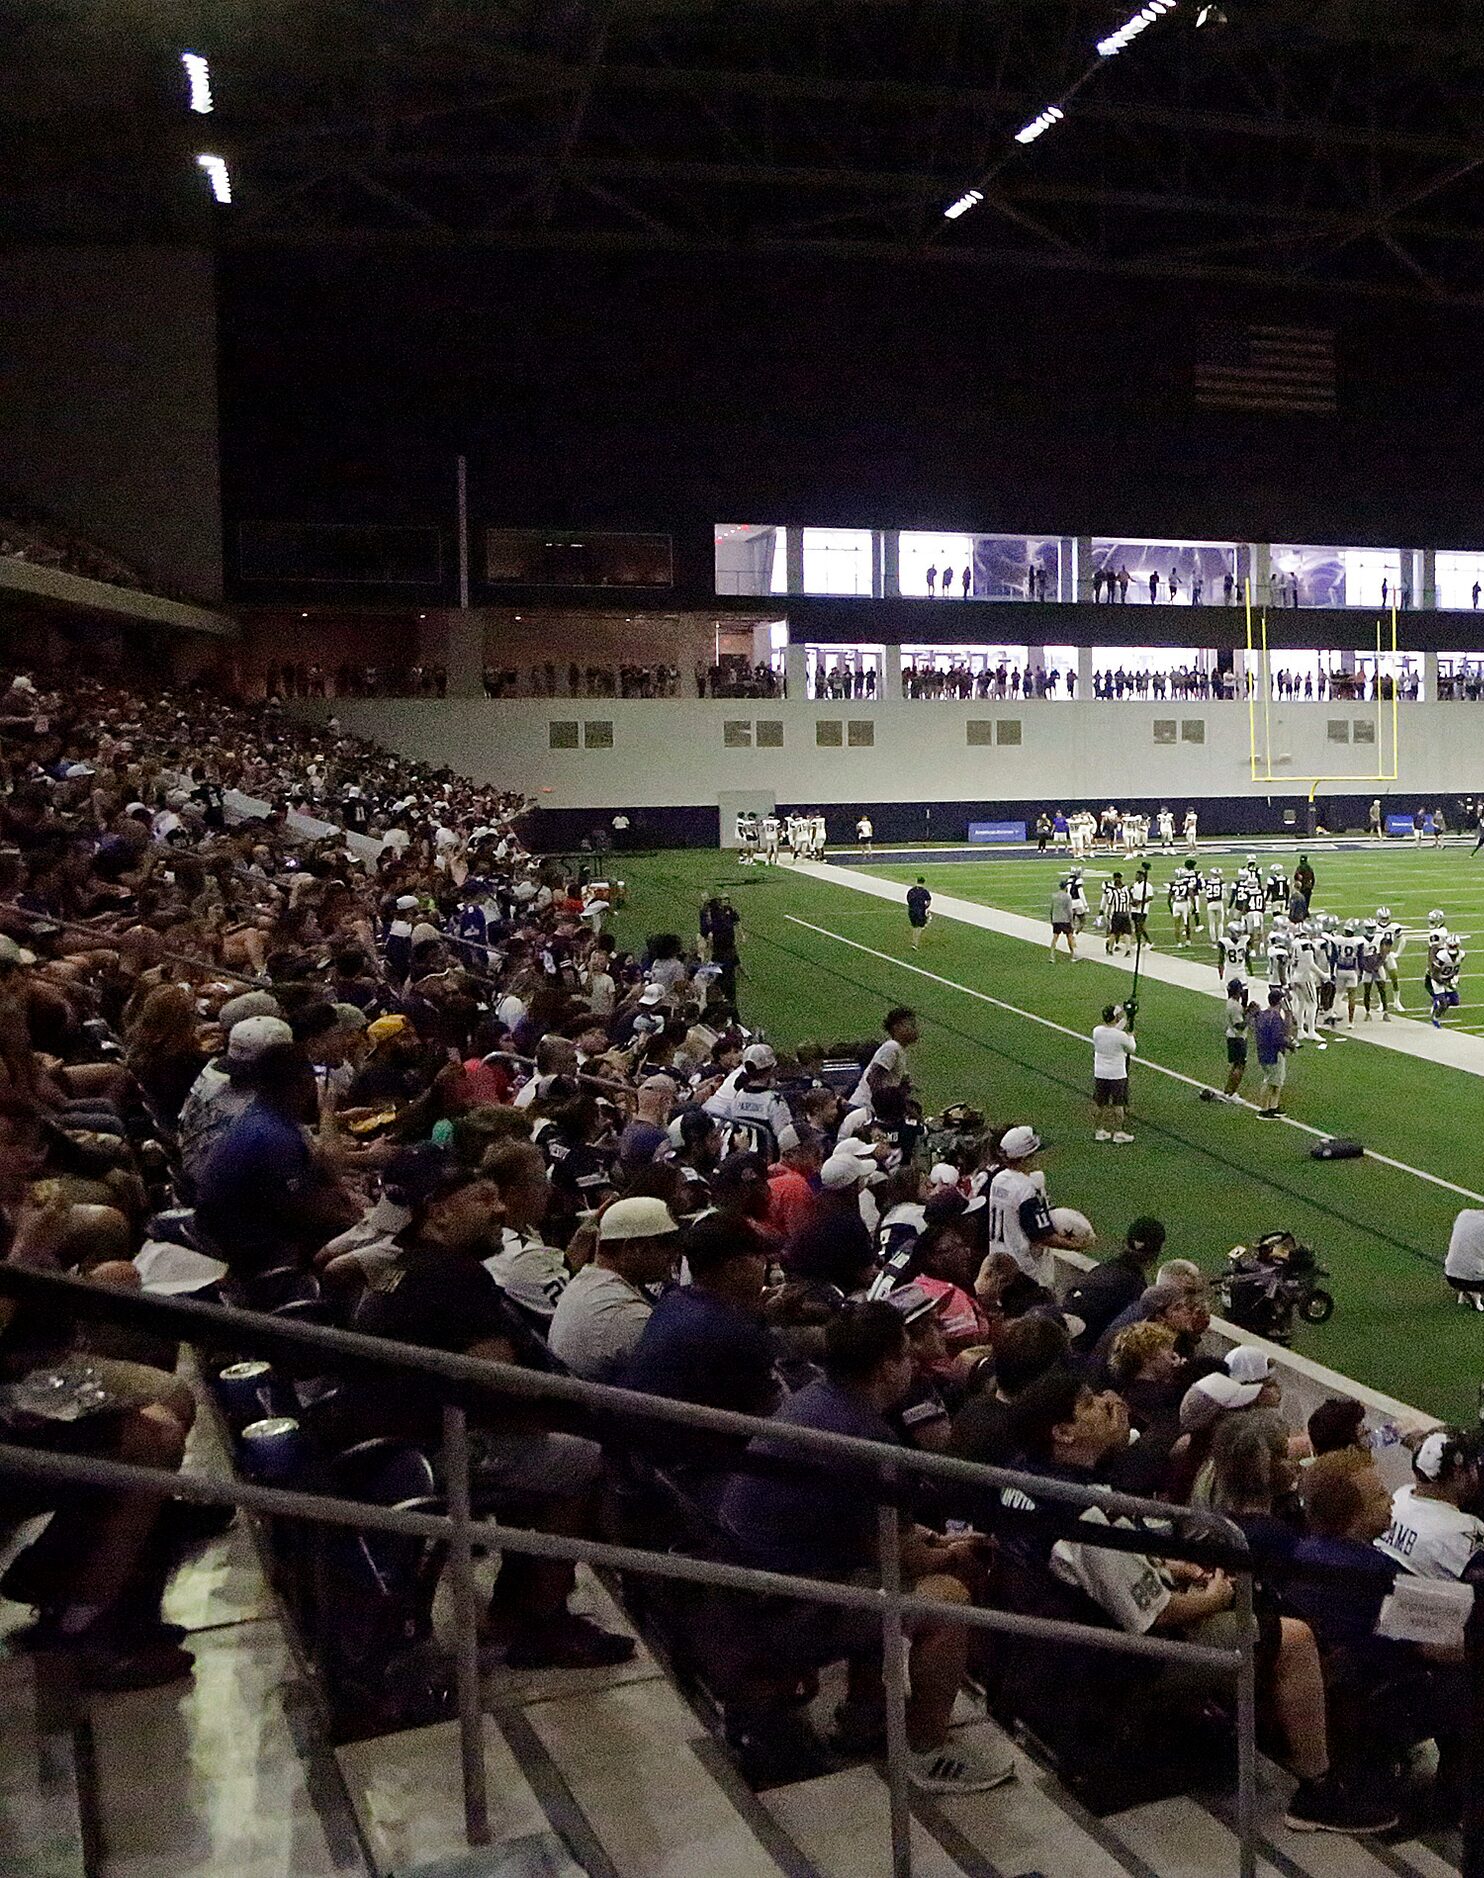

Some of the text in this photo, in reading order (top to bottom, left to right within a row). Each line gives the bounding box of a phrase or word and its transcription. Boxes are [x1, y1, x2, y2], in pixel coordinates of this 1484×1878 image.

[1206, 885, 1221, 898] 29
[1248, 896, 1263, 910] 40
[991, 1205, 1005, 1243] 11
